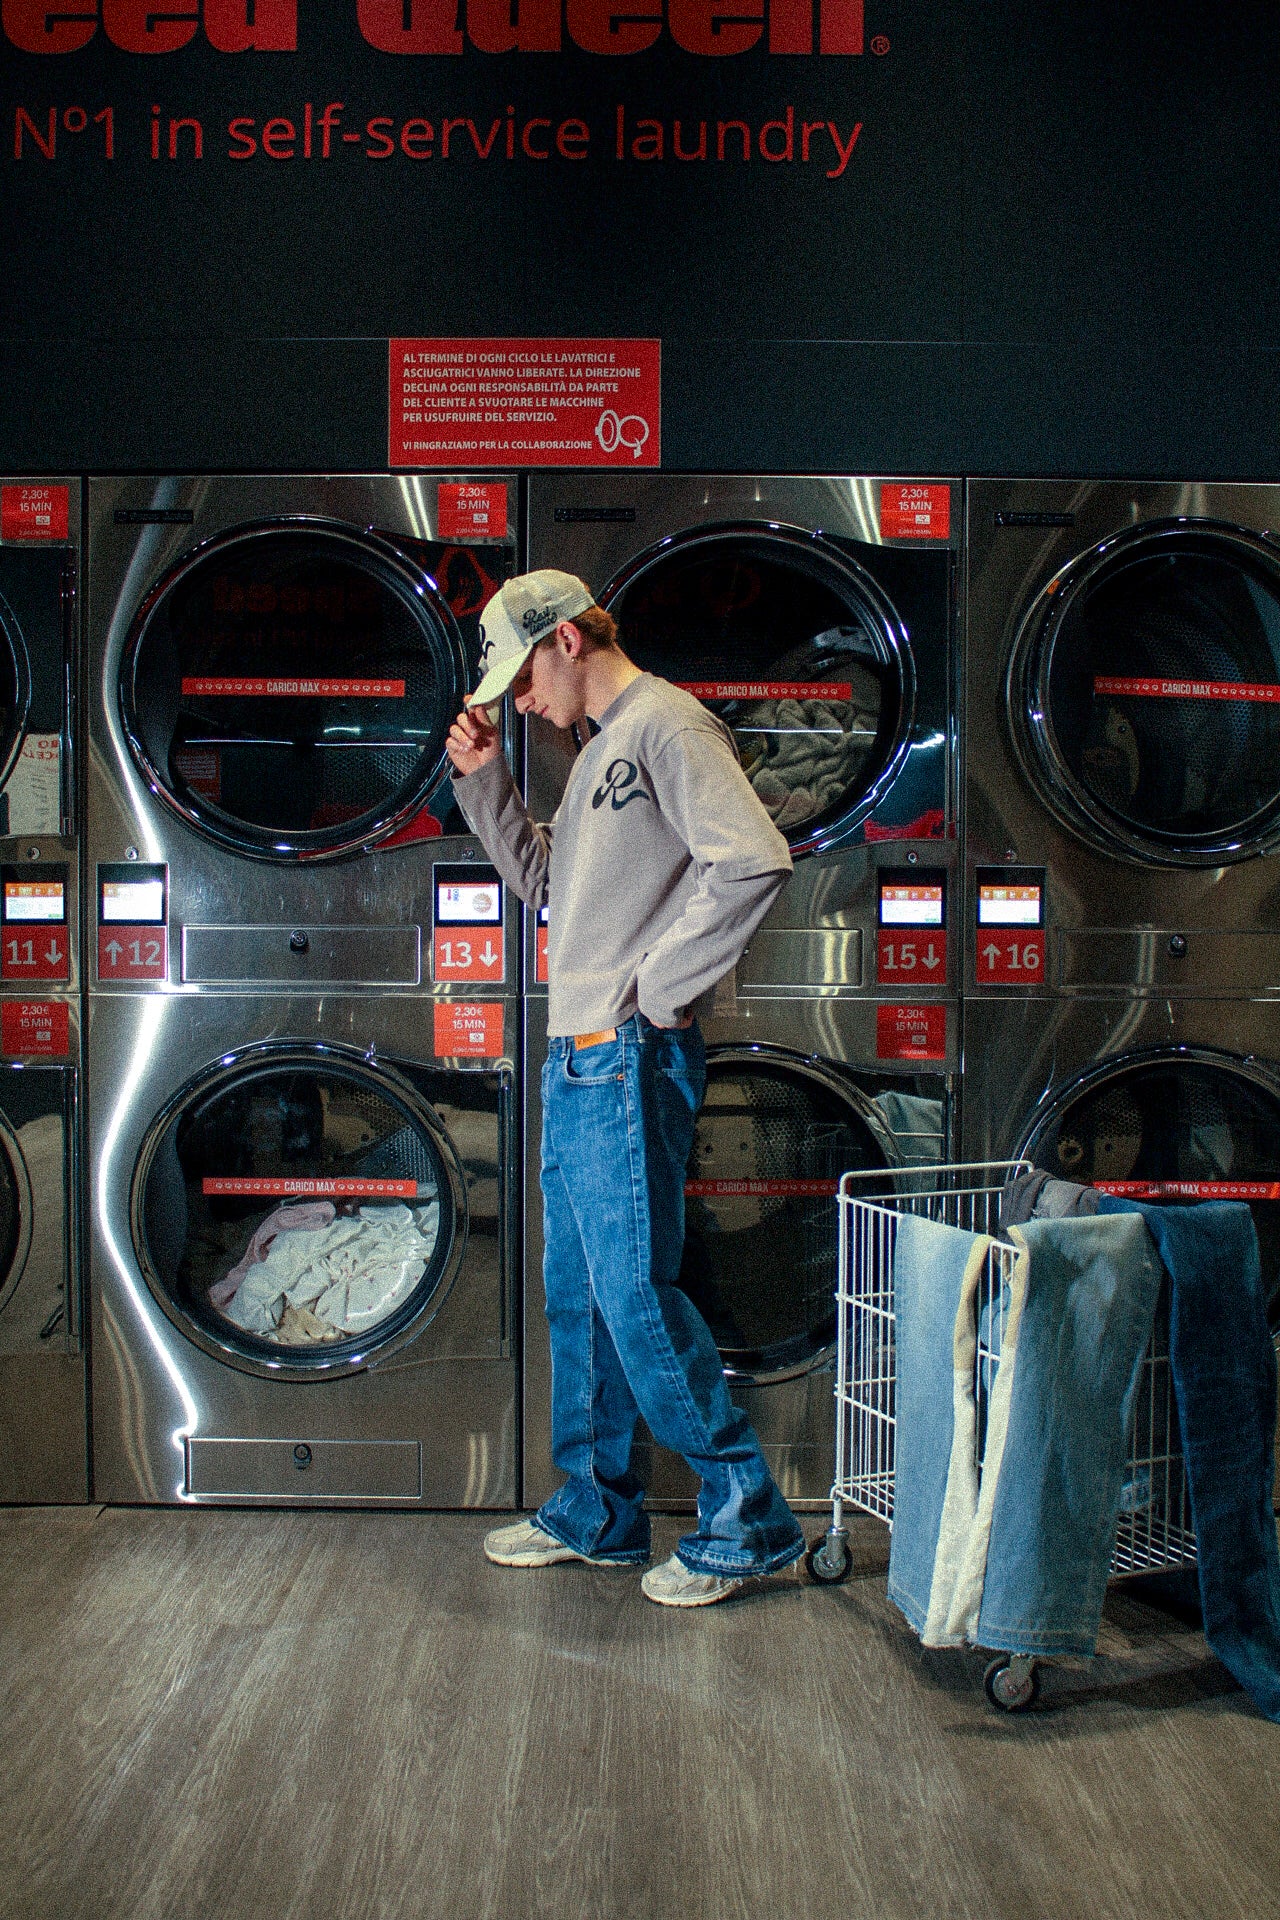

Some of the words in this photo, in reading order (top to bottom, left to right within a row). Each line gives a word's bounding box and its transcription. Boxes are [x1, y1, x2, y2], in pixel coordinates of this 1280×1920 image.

[150, 105, 204, 160] in
[227, 103, 591, 161] self-service
[615, 104, 864, 179] laundry
[403, 353, 417, 363] AL
[418, 353, 464, 363] TERMINE
[466, 353, 477, 363] DI
[479, 353, 506, 363] OGNI
[508, 353, 539, 363] CICLO
[540, 353, 553, 363] LE
[555, 353, 608, 363] LAVATRICI
[609, 353, 616, 363] E
[403, 368, 475, 378] ASCIUGATRICI
[476, 368, 515, 378] VANNO
[516, 368, 568, 378] LIBERATE.
[569, 368, 583, 378] LA
[585, 368, 641, 378] DIREZIONE
[403, 382, 448, 393] DECLINA
[449, 382, 477, 393] OGNI
[478, 380, 567, 393] RESPONSABILITÀ
[568, 382, 583, 393] DA
[585, 382, 619, 393] PARTE
[403, 397, 423, 407] DEL
[424, 397, 467, 407] CLIENTE
[469, 397, 477, 407] A
[478, 397, 534, 407] SVUOTARE
[535, 397, 548, 407] LE
[549, 397, 604, 407] MACCHINE
[403, 412, 423, 423] PER
[424, 412, 483, 423] USUFRUIRE
[484, 412, 505, 423] DEL
[506, 412, 557, 423] SERVIZIO.
[402, 440, 412, 450] VI
[413, 440, 478, 450] RINGRAZIAMO
[479, 440, 497, 450] PER
[498, 440, 509, 450] LA
[511, 440, 593, 450] COLLABORAZIONE
[31, 502, 52, 512] MIN
[468, 500, 491, 510] MIN
[910, 501, 933, 511] MIN
[266, 681, 298, 693] CARICO
[299, 682, 320, 693] MAX
[716, 685, 748, 697] CARICO
[749, 685, 769, 697] MAX
[1161, 683, 1191, 695] CARICO
[1192, 684, 1211, 696] MAX
[592, 758, 651, 811] R
[6, 940, 37, 965] 11
[128, 940, 161, 966] 12
[439, 941, 473, 969] 13
[882, 943, 917, 970] 15
[1006, 943, 1040, 970] 16
[32, 1018, 52, 1028] MIN
[464, 1019, 487, 1030] MIN
[284, 1181, 315, 1192] CARICO
[316, 1181, 336, 1192] MAX
